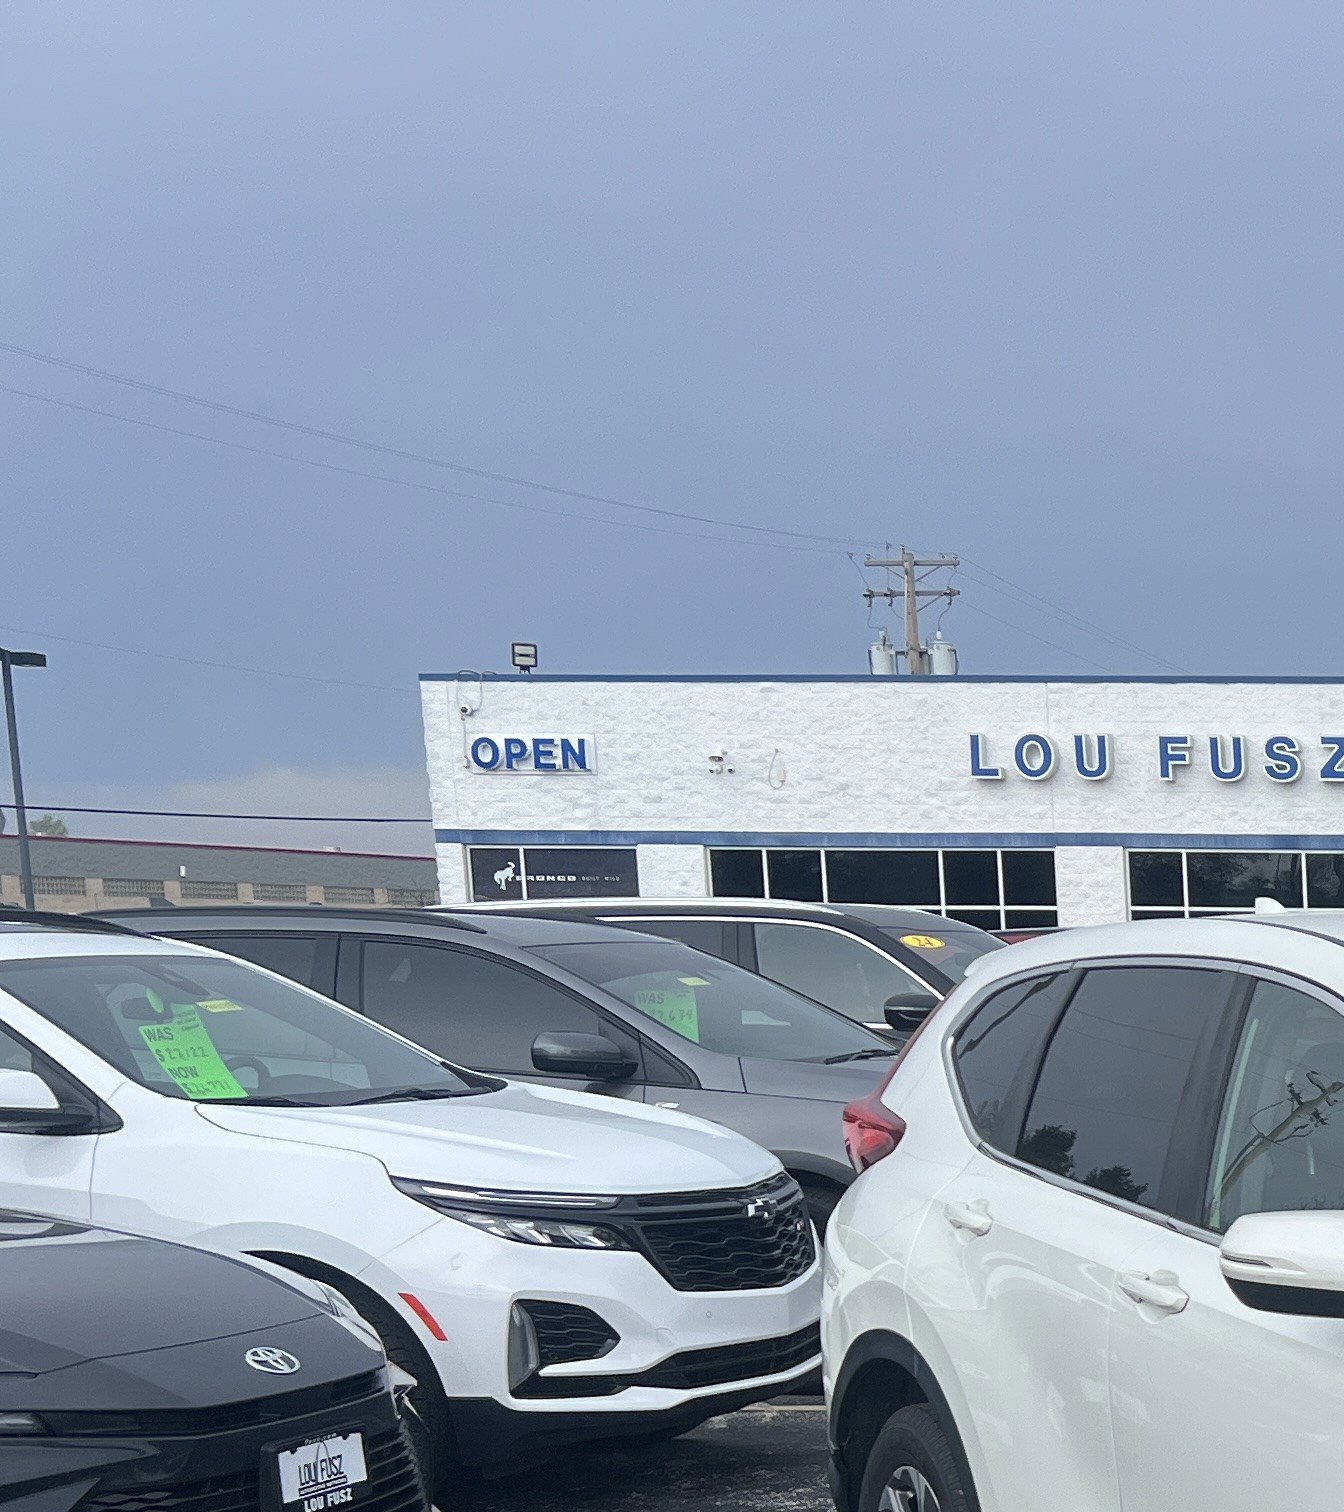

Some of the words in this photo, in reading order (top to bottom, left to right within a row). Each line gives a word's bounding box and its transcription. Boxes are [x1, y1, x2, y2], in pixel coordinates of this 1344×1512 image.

[471, 737, 588, 770] OPEN
[971, 734, 1111, 780] LOU
[143, 1027, 173, 1043] WAS
[167, 1065, 200, 1080] NOW
[327, 1488, 353, 1507] FUSZ
